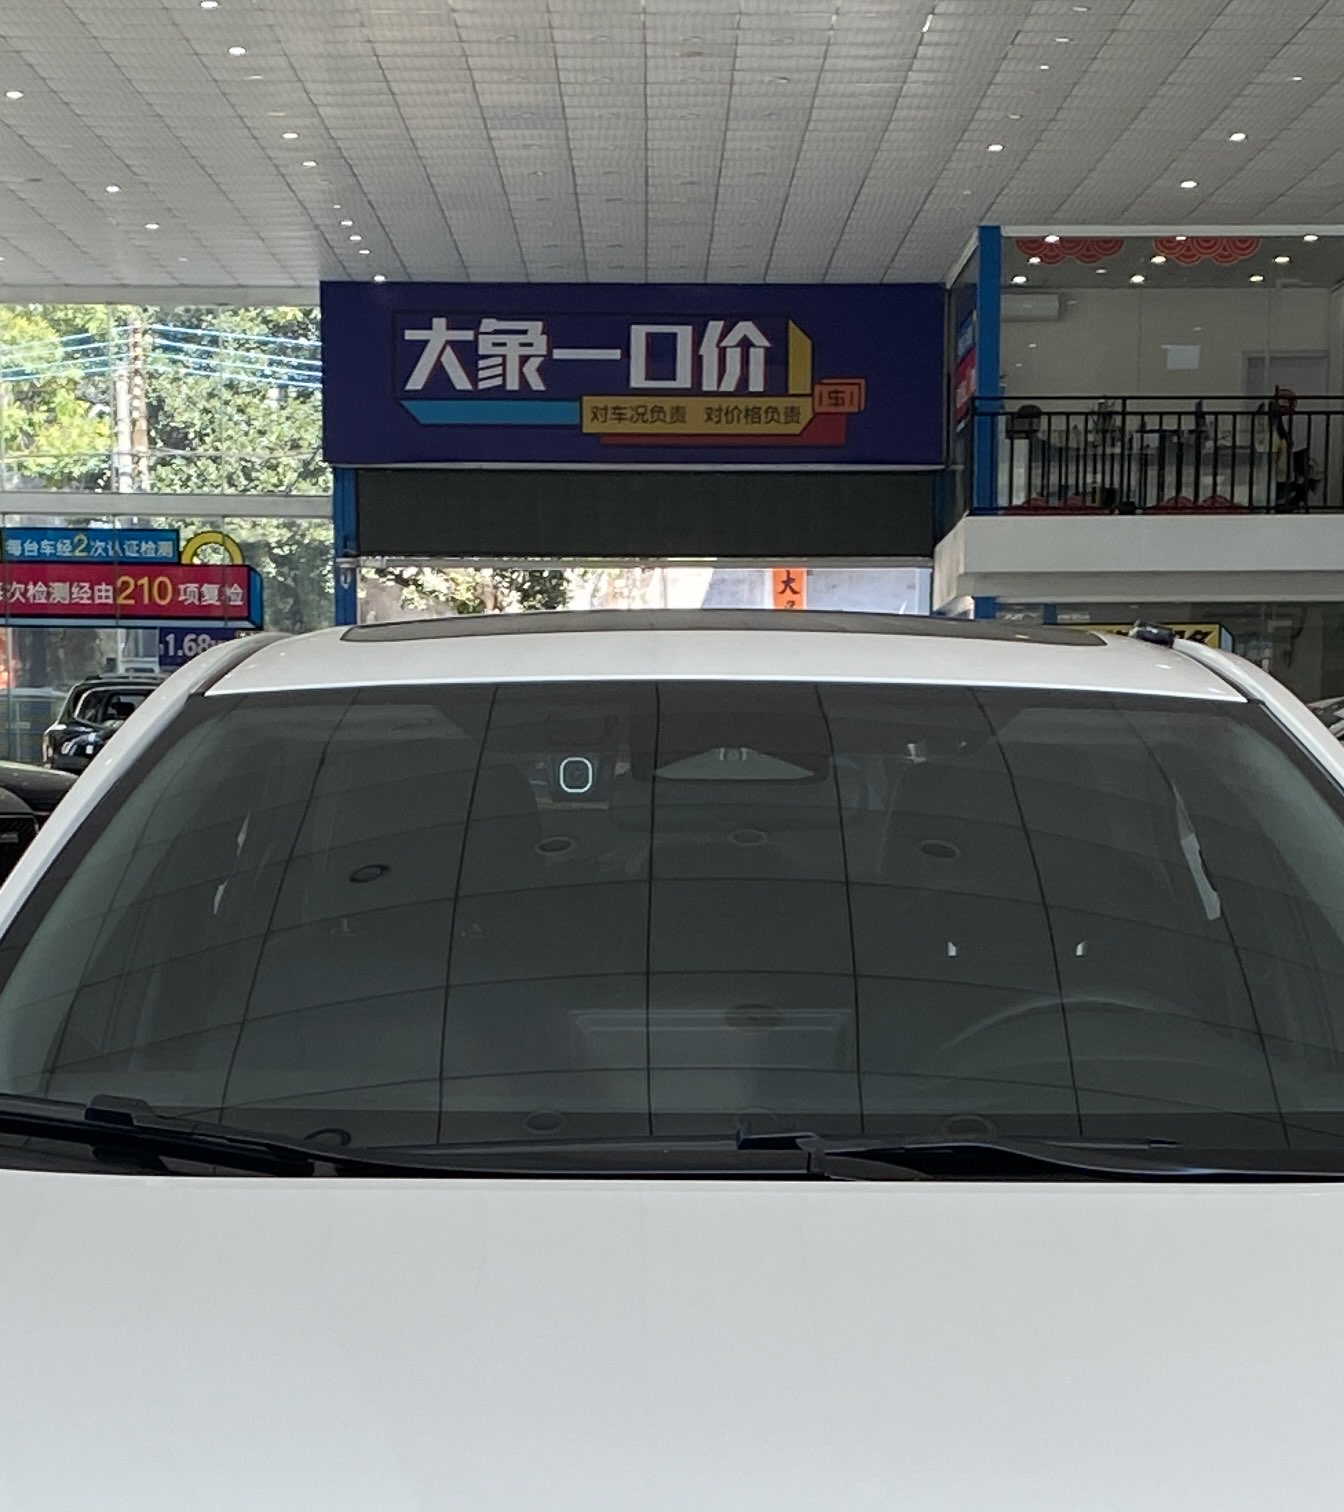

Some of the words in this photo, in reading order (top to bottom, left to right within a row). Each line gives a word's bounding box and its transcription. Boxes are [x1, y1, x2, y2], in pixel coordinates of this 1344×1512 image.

[404, 317, 771, 392] 大象一口价
[590, 404, 687, 424] 对车况负责
[704, 404, 801, 425] 对价格负责
[6, 533, 173, 558] 每台车经2次认证检测
[165, 633, 216, 657] 1.68
